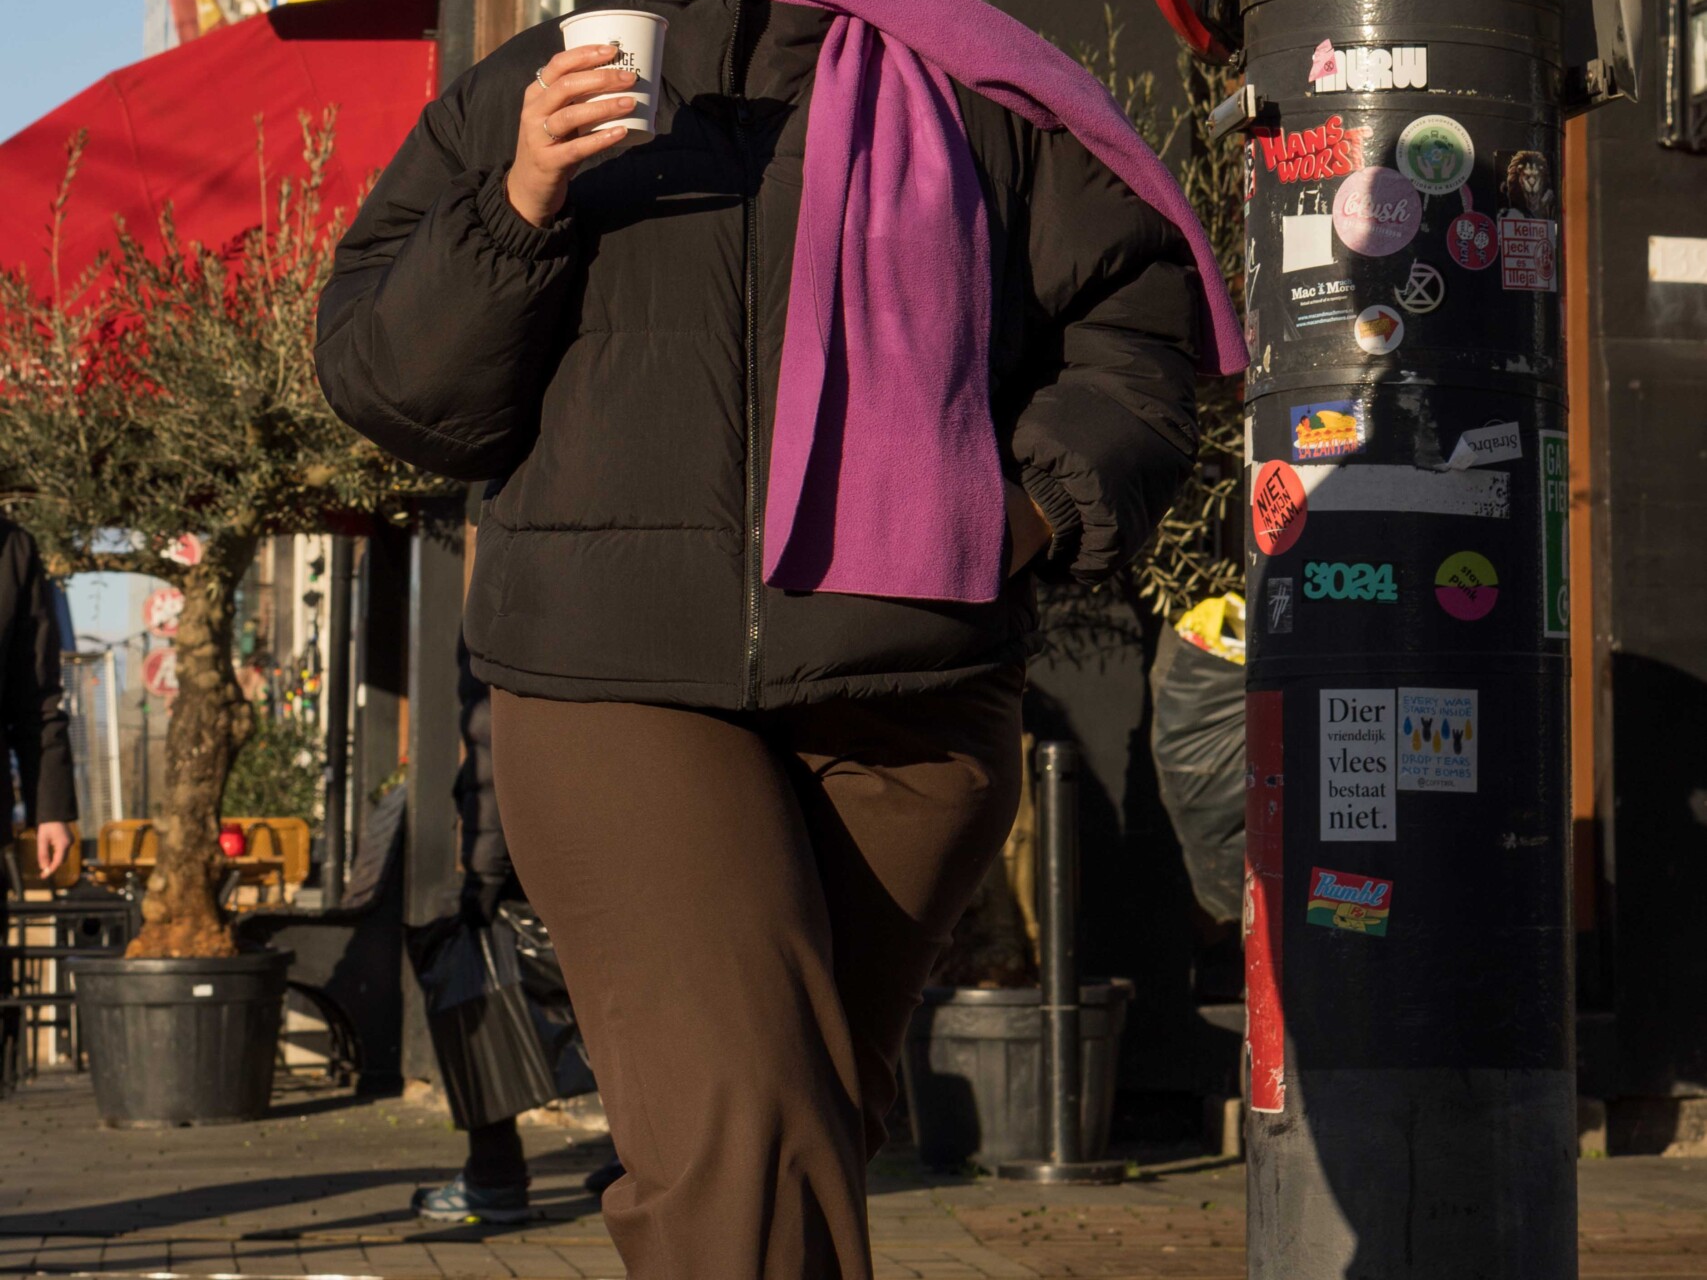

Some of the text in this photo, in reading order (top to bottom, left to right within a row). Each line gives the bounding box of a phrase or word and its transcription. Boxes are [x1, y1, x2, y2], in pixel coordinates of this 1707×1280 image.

[1252, 114, 1344, 172] HANS
[1277, 125, 1374, 183] WORST
[1343, 192, 1411, 223] blush
[1514, 223, 1545, 237] keine
[1291, 285, 1316, 300] Mac
[1256, 467, 1286, 518] NIET
[1263, 489, 1292, 529] IN MIJN
[1303, 562, 1398, 600] 3024
[1448, 574, 1478, 602] punk
[1461, 566, 1483, 587] stay
[1328, 697, 1386, 723] Dier
[1403, 695, 1472, 707] EVERY WAR
[1403, 705, 1472, 717] STARTS INSIDE
[1328, 729, 1386, 745] vriendelijk
[1328, 748, 1387, 773] vlees
[1402, 753, 1471, 767] DROP TEARS
[1402, 767, 1472, 779] NOT BOMBS
[1329, 780, 1386, 798] bestaat
[1329, 803, 1388, 830] niet.
